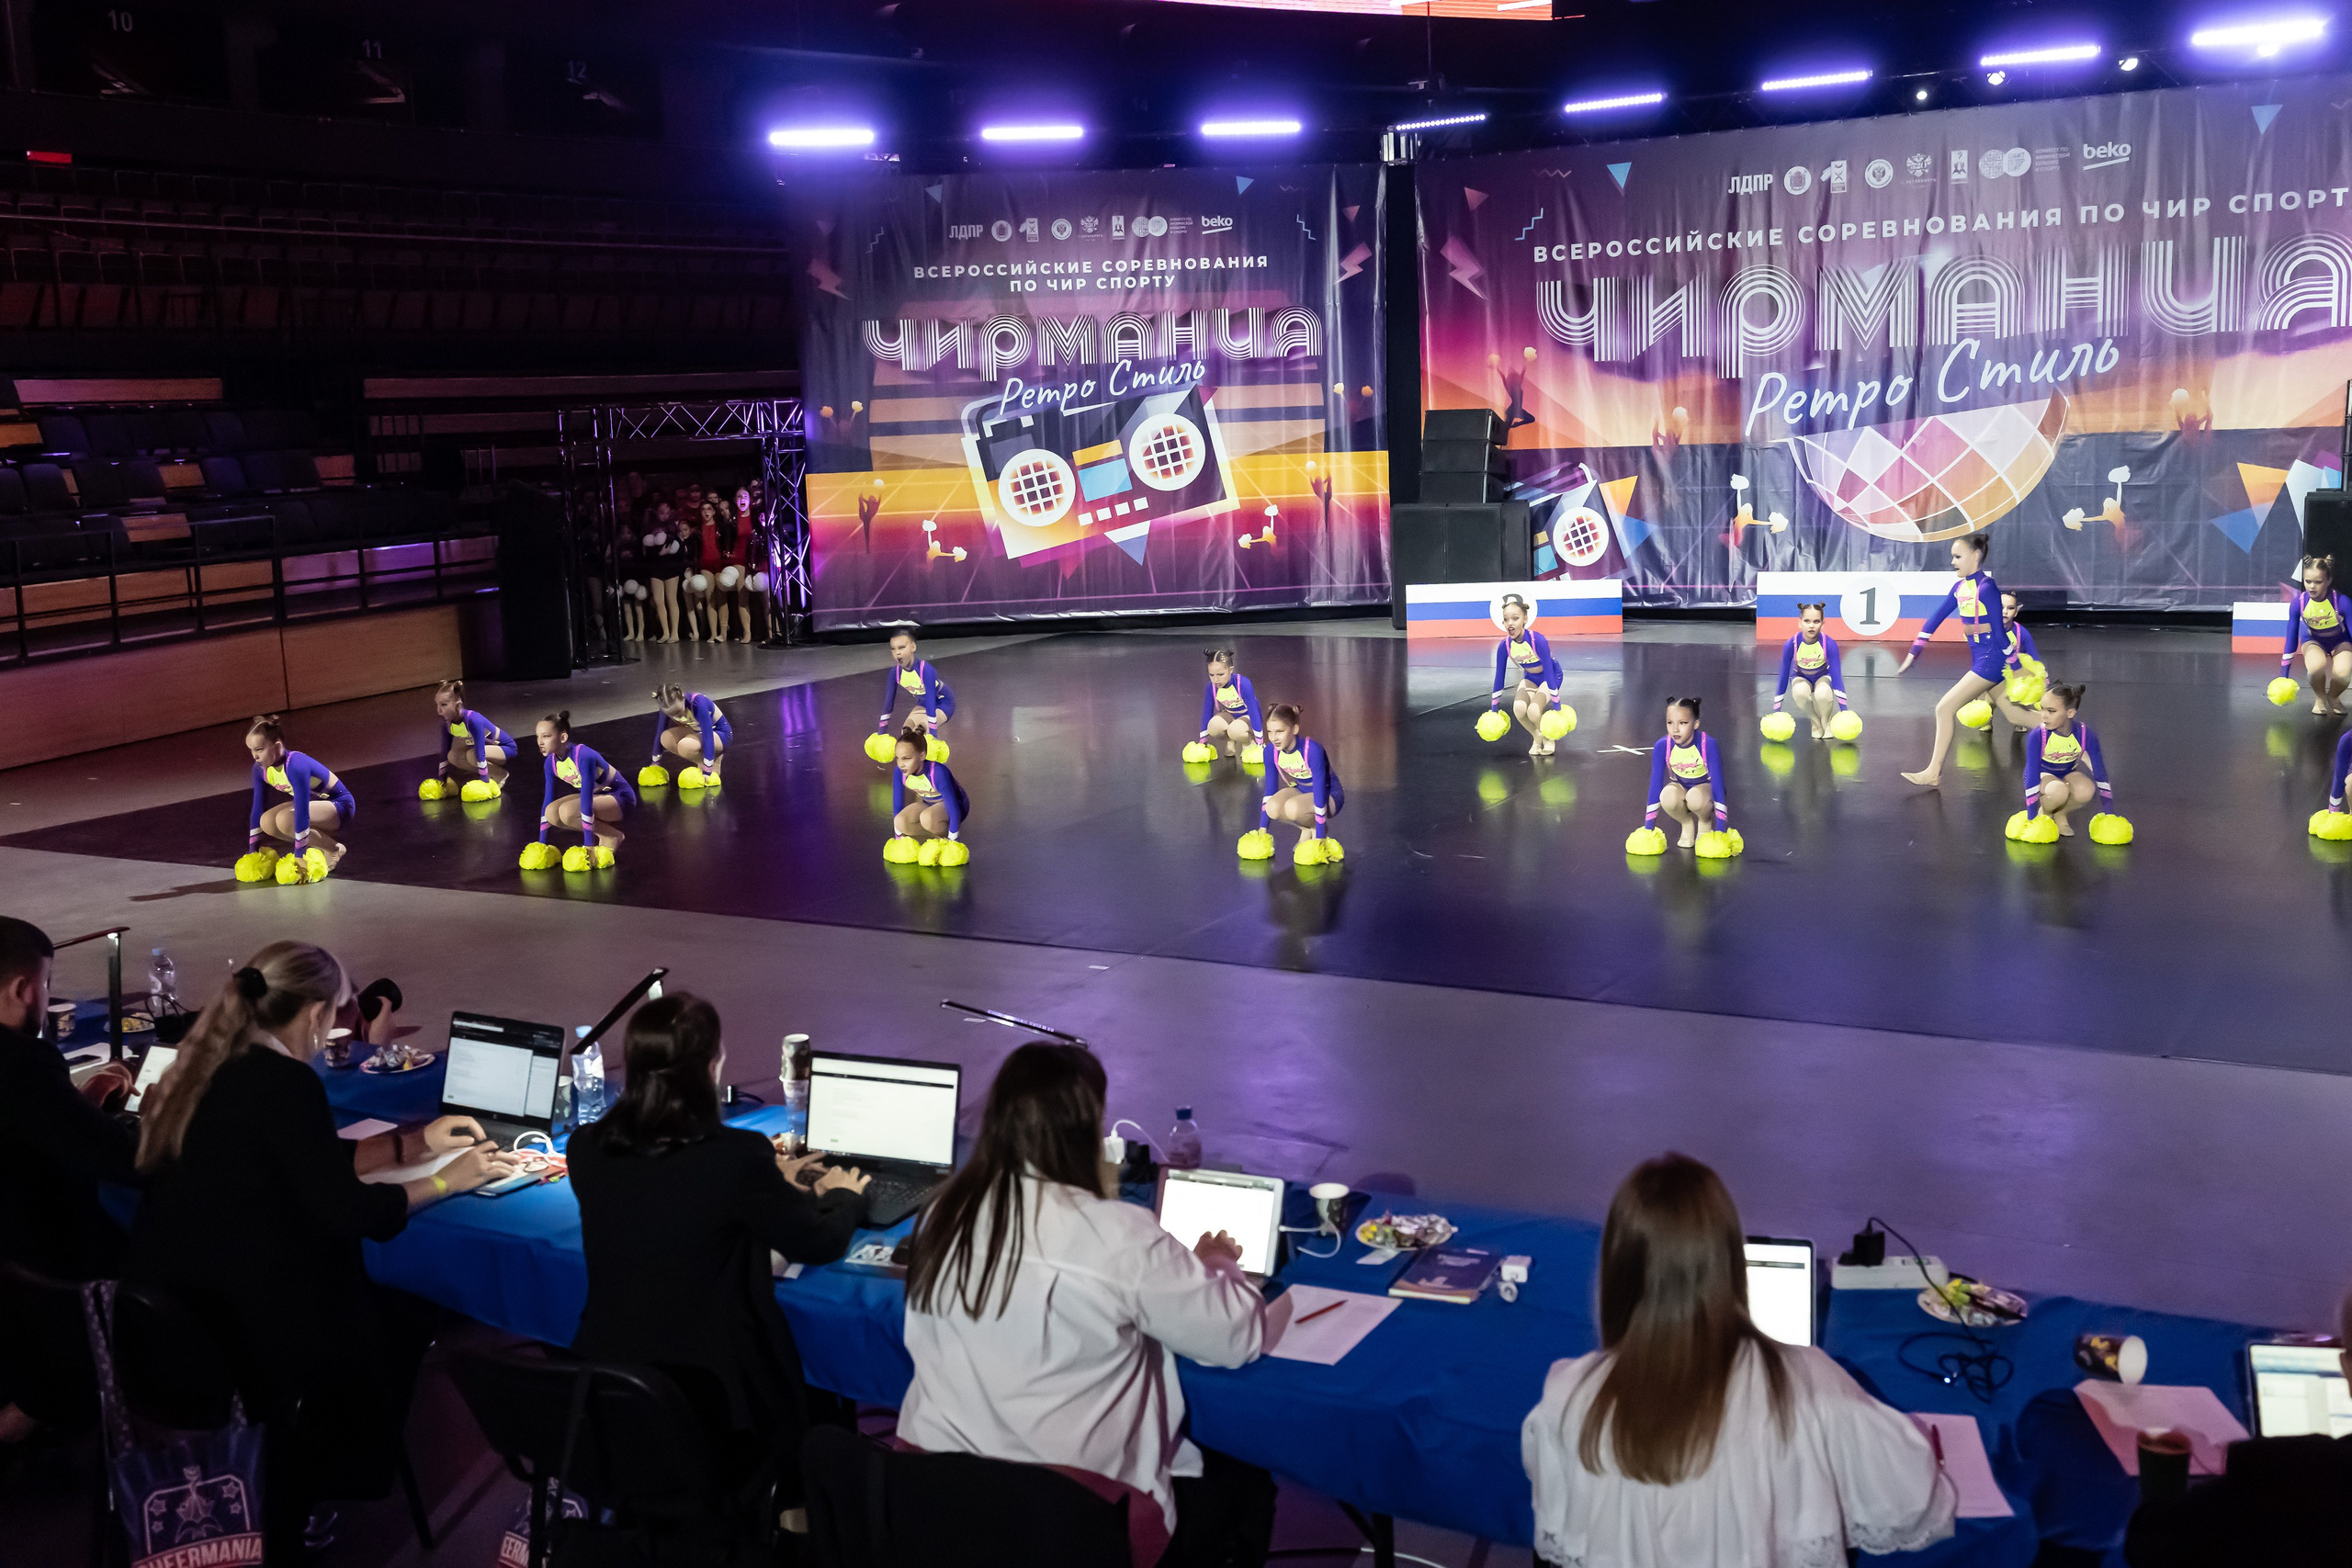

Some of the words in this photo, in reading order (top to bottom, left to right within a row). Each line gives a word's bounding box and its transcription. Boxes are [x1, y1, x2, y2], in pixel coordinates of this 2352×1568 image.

[107, 9, 133, 32] 10
[362, 39, 382, 59] 11
[2083, 141, 2132, 160] beko
[1728, 174, 1773, 196] ЛДПР
[949, 224, 983, 240] ЛДПР
[1201, 215, 1233, 227] beko
[1533, 228, 1782, 263] ВСЕРОССИЙСКИЕ
[1798, 207, 2063, 244] СОРЕВНОВАНИЯ
[2080, 203, 2125, 224] ПО
[2142, 198, 2211, 220] ЧИР
[913, 260, 1092, 278] ВСЕРОССИЙСКИЕ
[1102, 255, 1268, 273] СОРЕВНОВАНИЯ
[1010, 279, 1037, 292] ПО
[1046, 277, 1087, 291] ЧИР
[1096, 275, 1176, 289] СПОРТУ
[1000, 378, 1096, 416] Ретро
[1109, 359, 1205, 396] Стиль
[1746, 371, 1913, 436] Ретро
[1937, 338, 2120, 403] Стиль
[1860, 587, 1881, 625] 1
